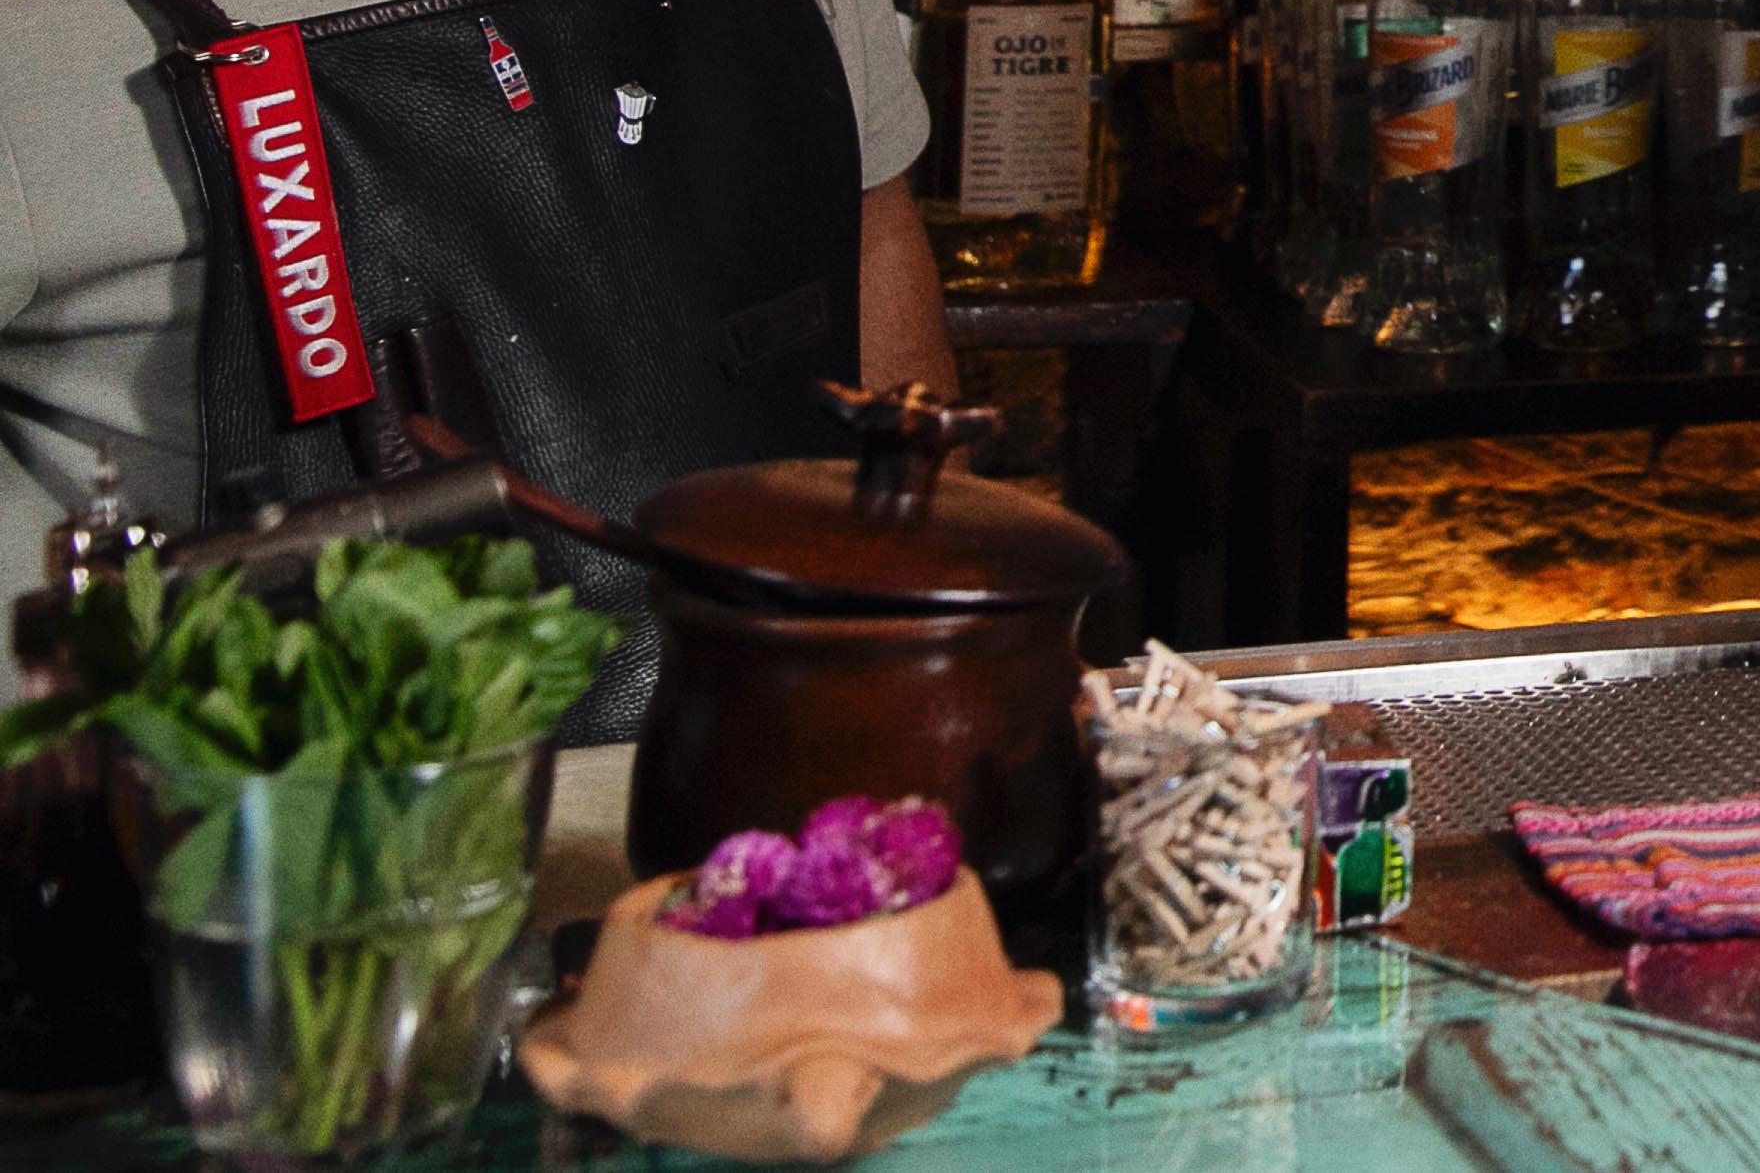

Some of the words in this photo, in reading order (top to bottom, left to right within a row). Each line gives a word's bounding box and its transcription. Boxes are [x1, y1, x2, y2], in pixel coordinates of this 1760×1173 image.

[993, 34, 1047, 54] OJO
[992, 56, 1070, 75] TIGRE
[239, 89, 348, 379] LUXARDO
